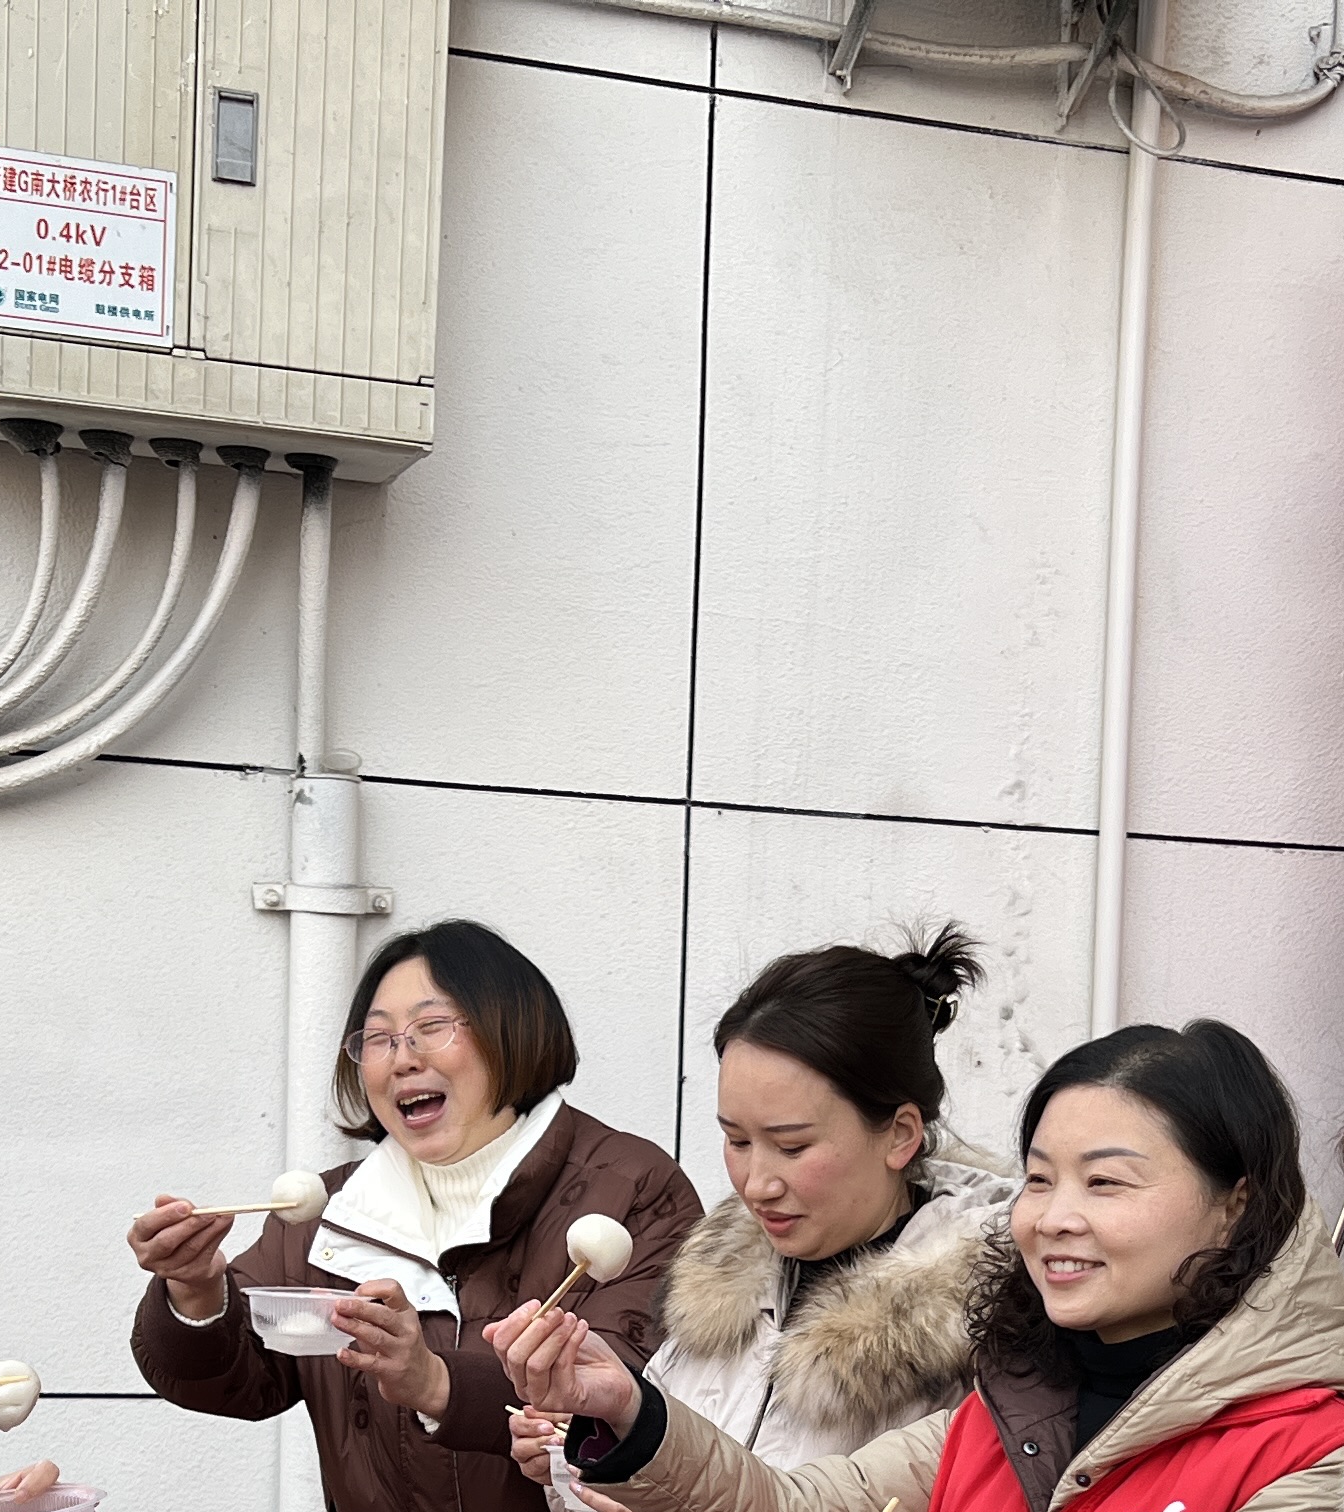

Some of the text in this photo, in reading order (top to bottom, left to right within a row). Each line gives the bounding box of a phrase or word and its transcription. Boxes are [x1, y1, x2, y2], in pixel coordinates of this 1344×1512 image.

[36, 218, 107, 247] 0.4kV
[14, 288, 60, 305] 国家电网
